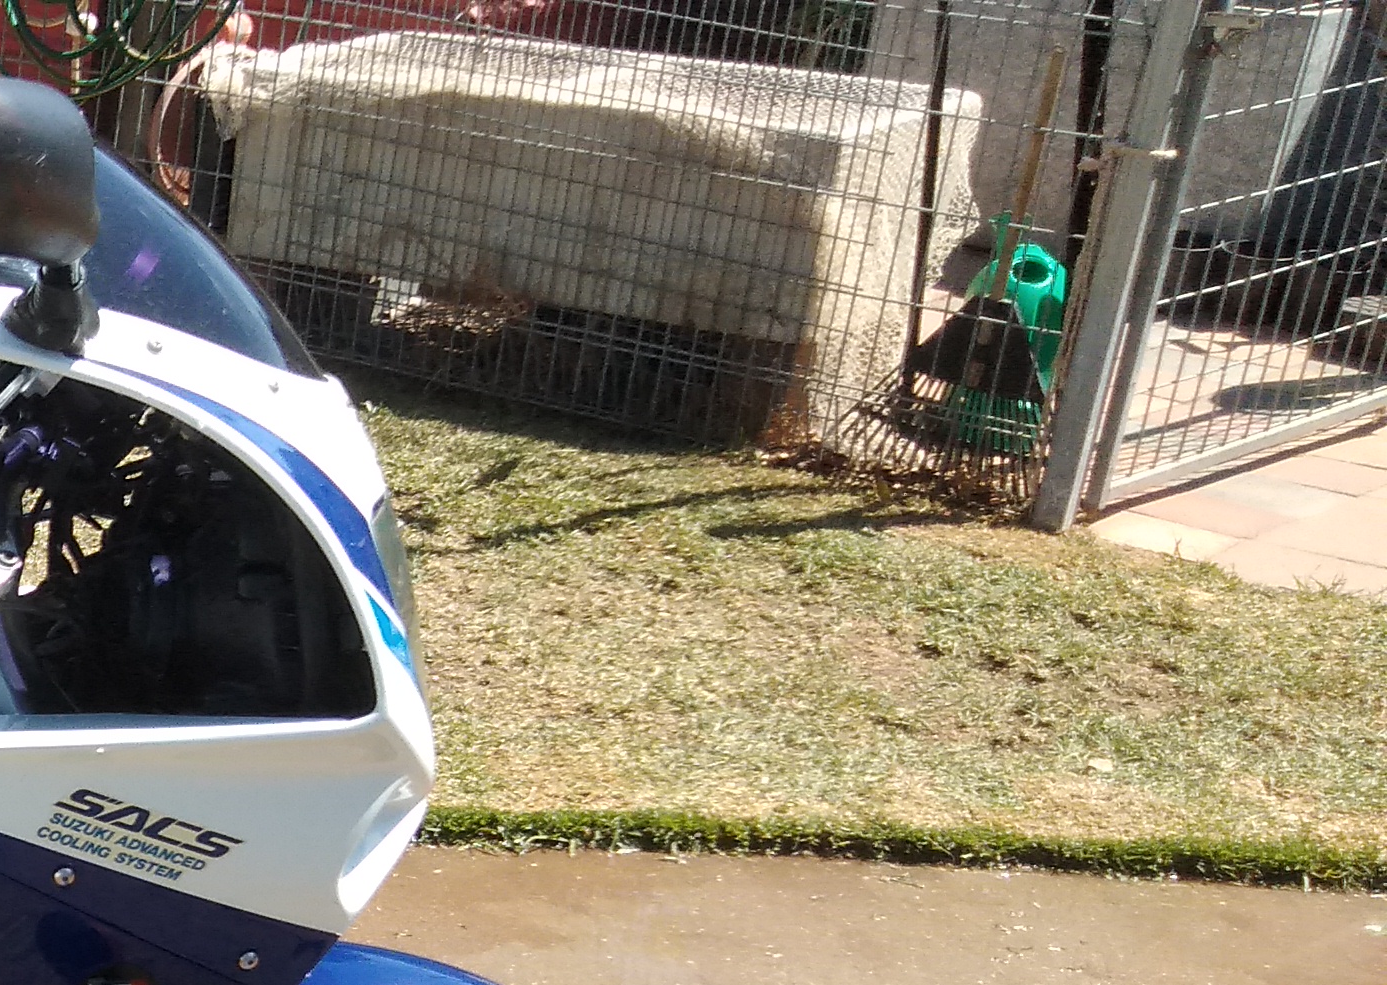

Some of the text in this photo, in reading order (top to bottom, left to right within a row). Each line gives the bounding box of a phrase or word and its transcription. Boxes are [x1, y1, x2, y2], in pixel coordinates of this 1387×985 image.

[50, 813, 206, 871] SUZUKI ADVANCED
[54, 789, 244, 858] SACS
[37, 827, 182, 881] COOLING SYSTEM
